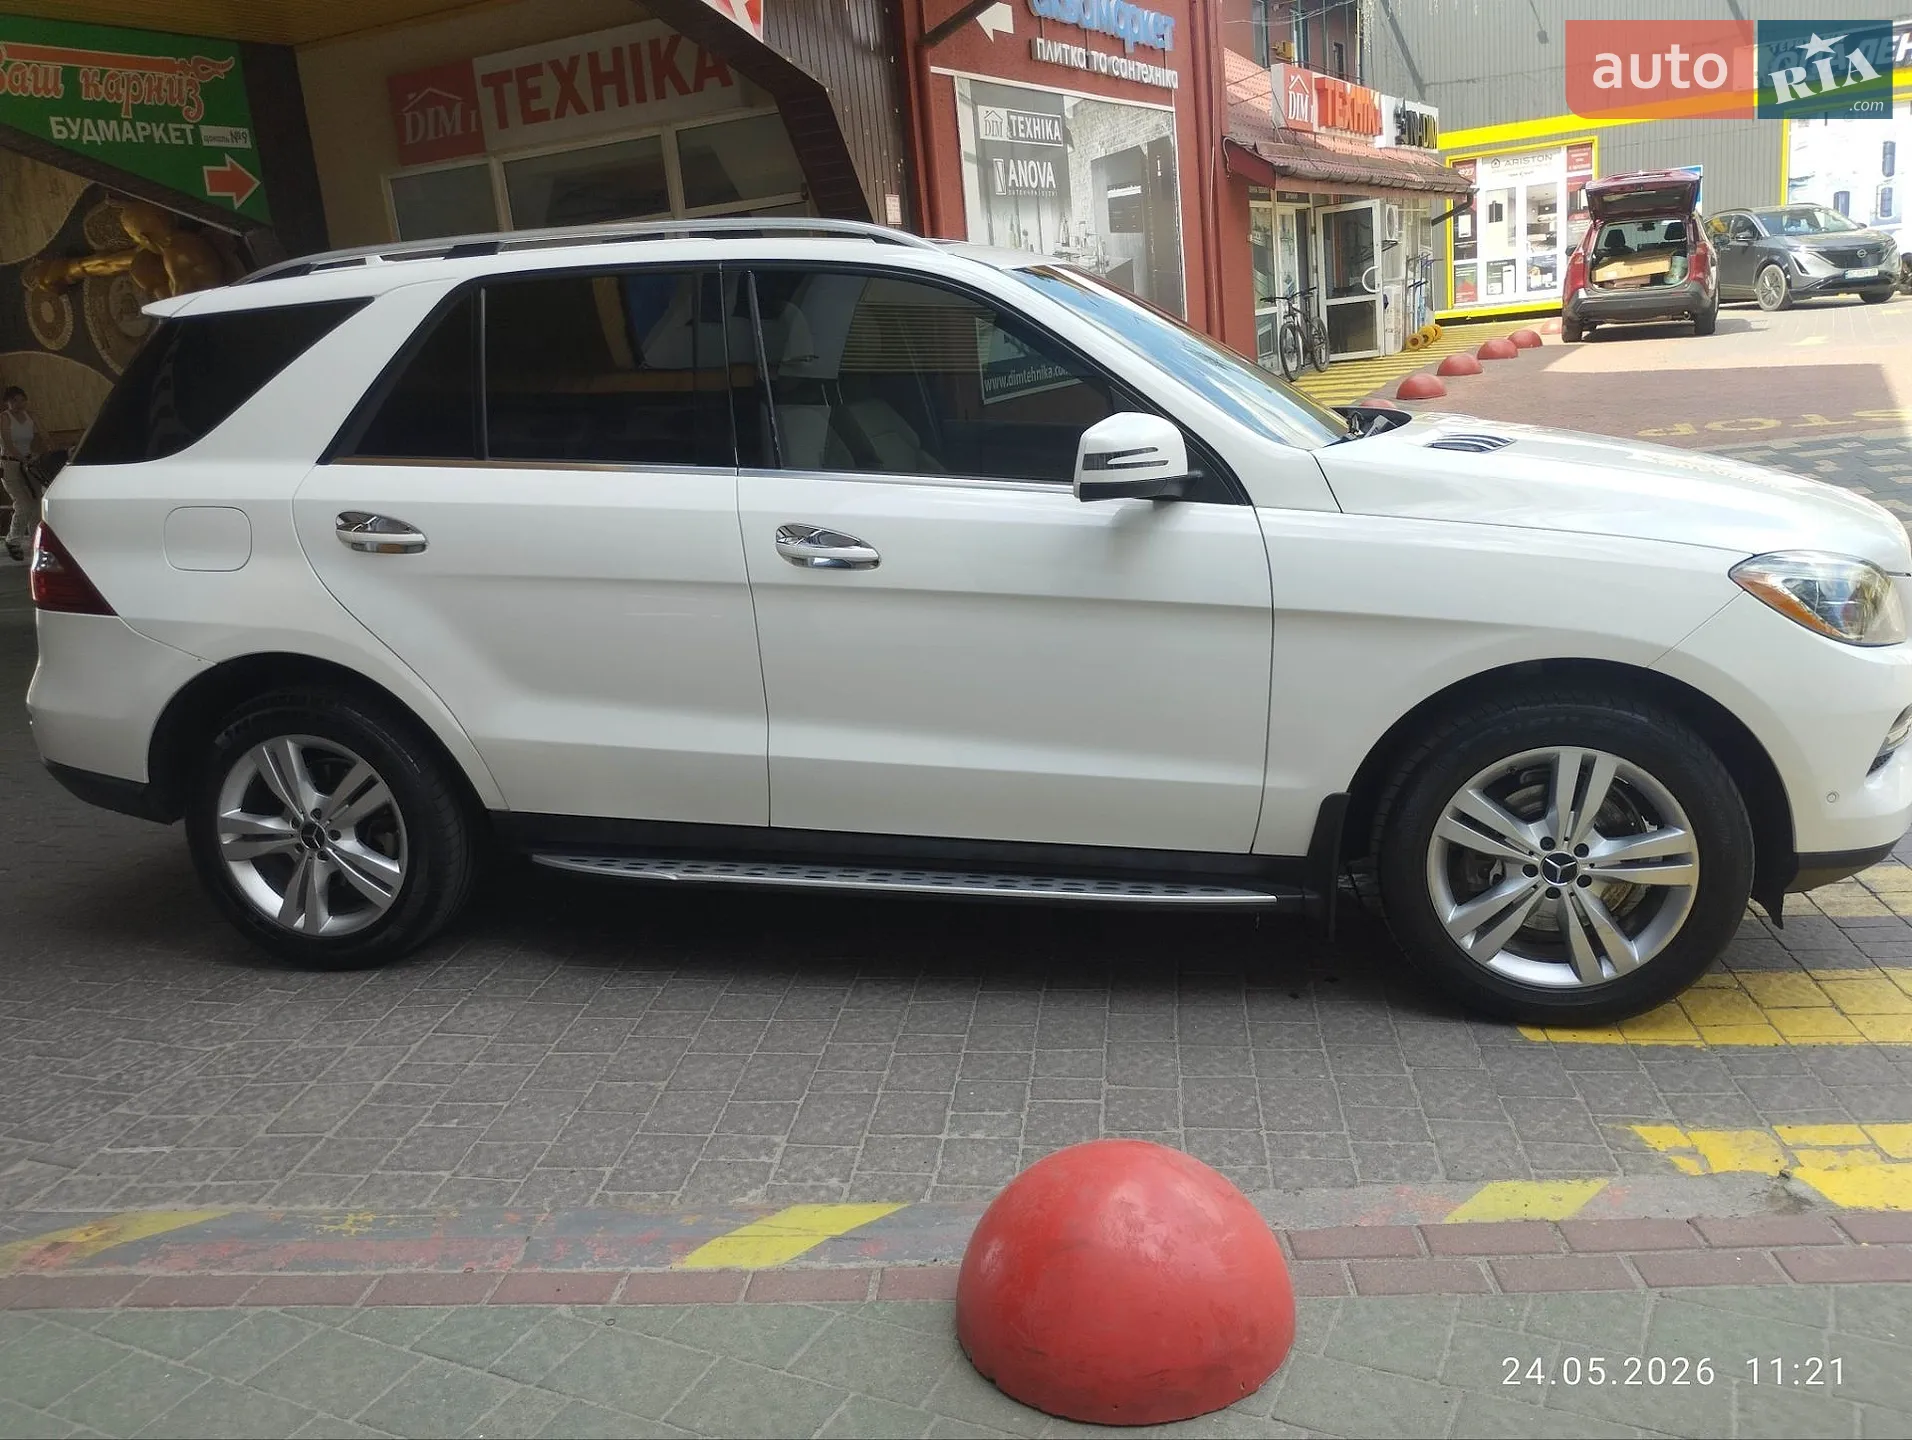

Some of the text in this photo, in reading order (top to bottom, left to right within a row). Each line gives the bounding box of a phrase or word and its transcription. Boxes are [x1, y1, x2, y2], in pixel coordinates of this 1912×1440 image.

[1288, 90, 1309, 123] DIM
[50, 116, 196, 145] БУДМАРКЕТ
[1009, 114, 1062, 142] ТЕХНІКА
[1008, 159, 1057, 189] ANOVA
[1504, 153, 1553, 167] ARISTON
